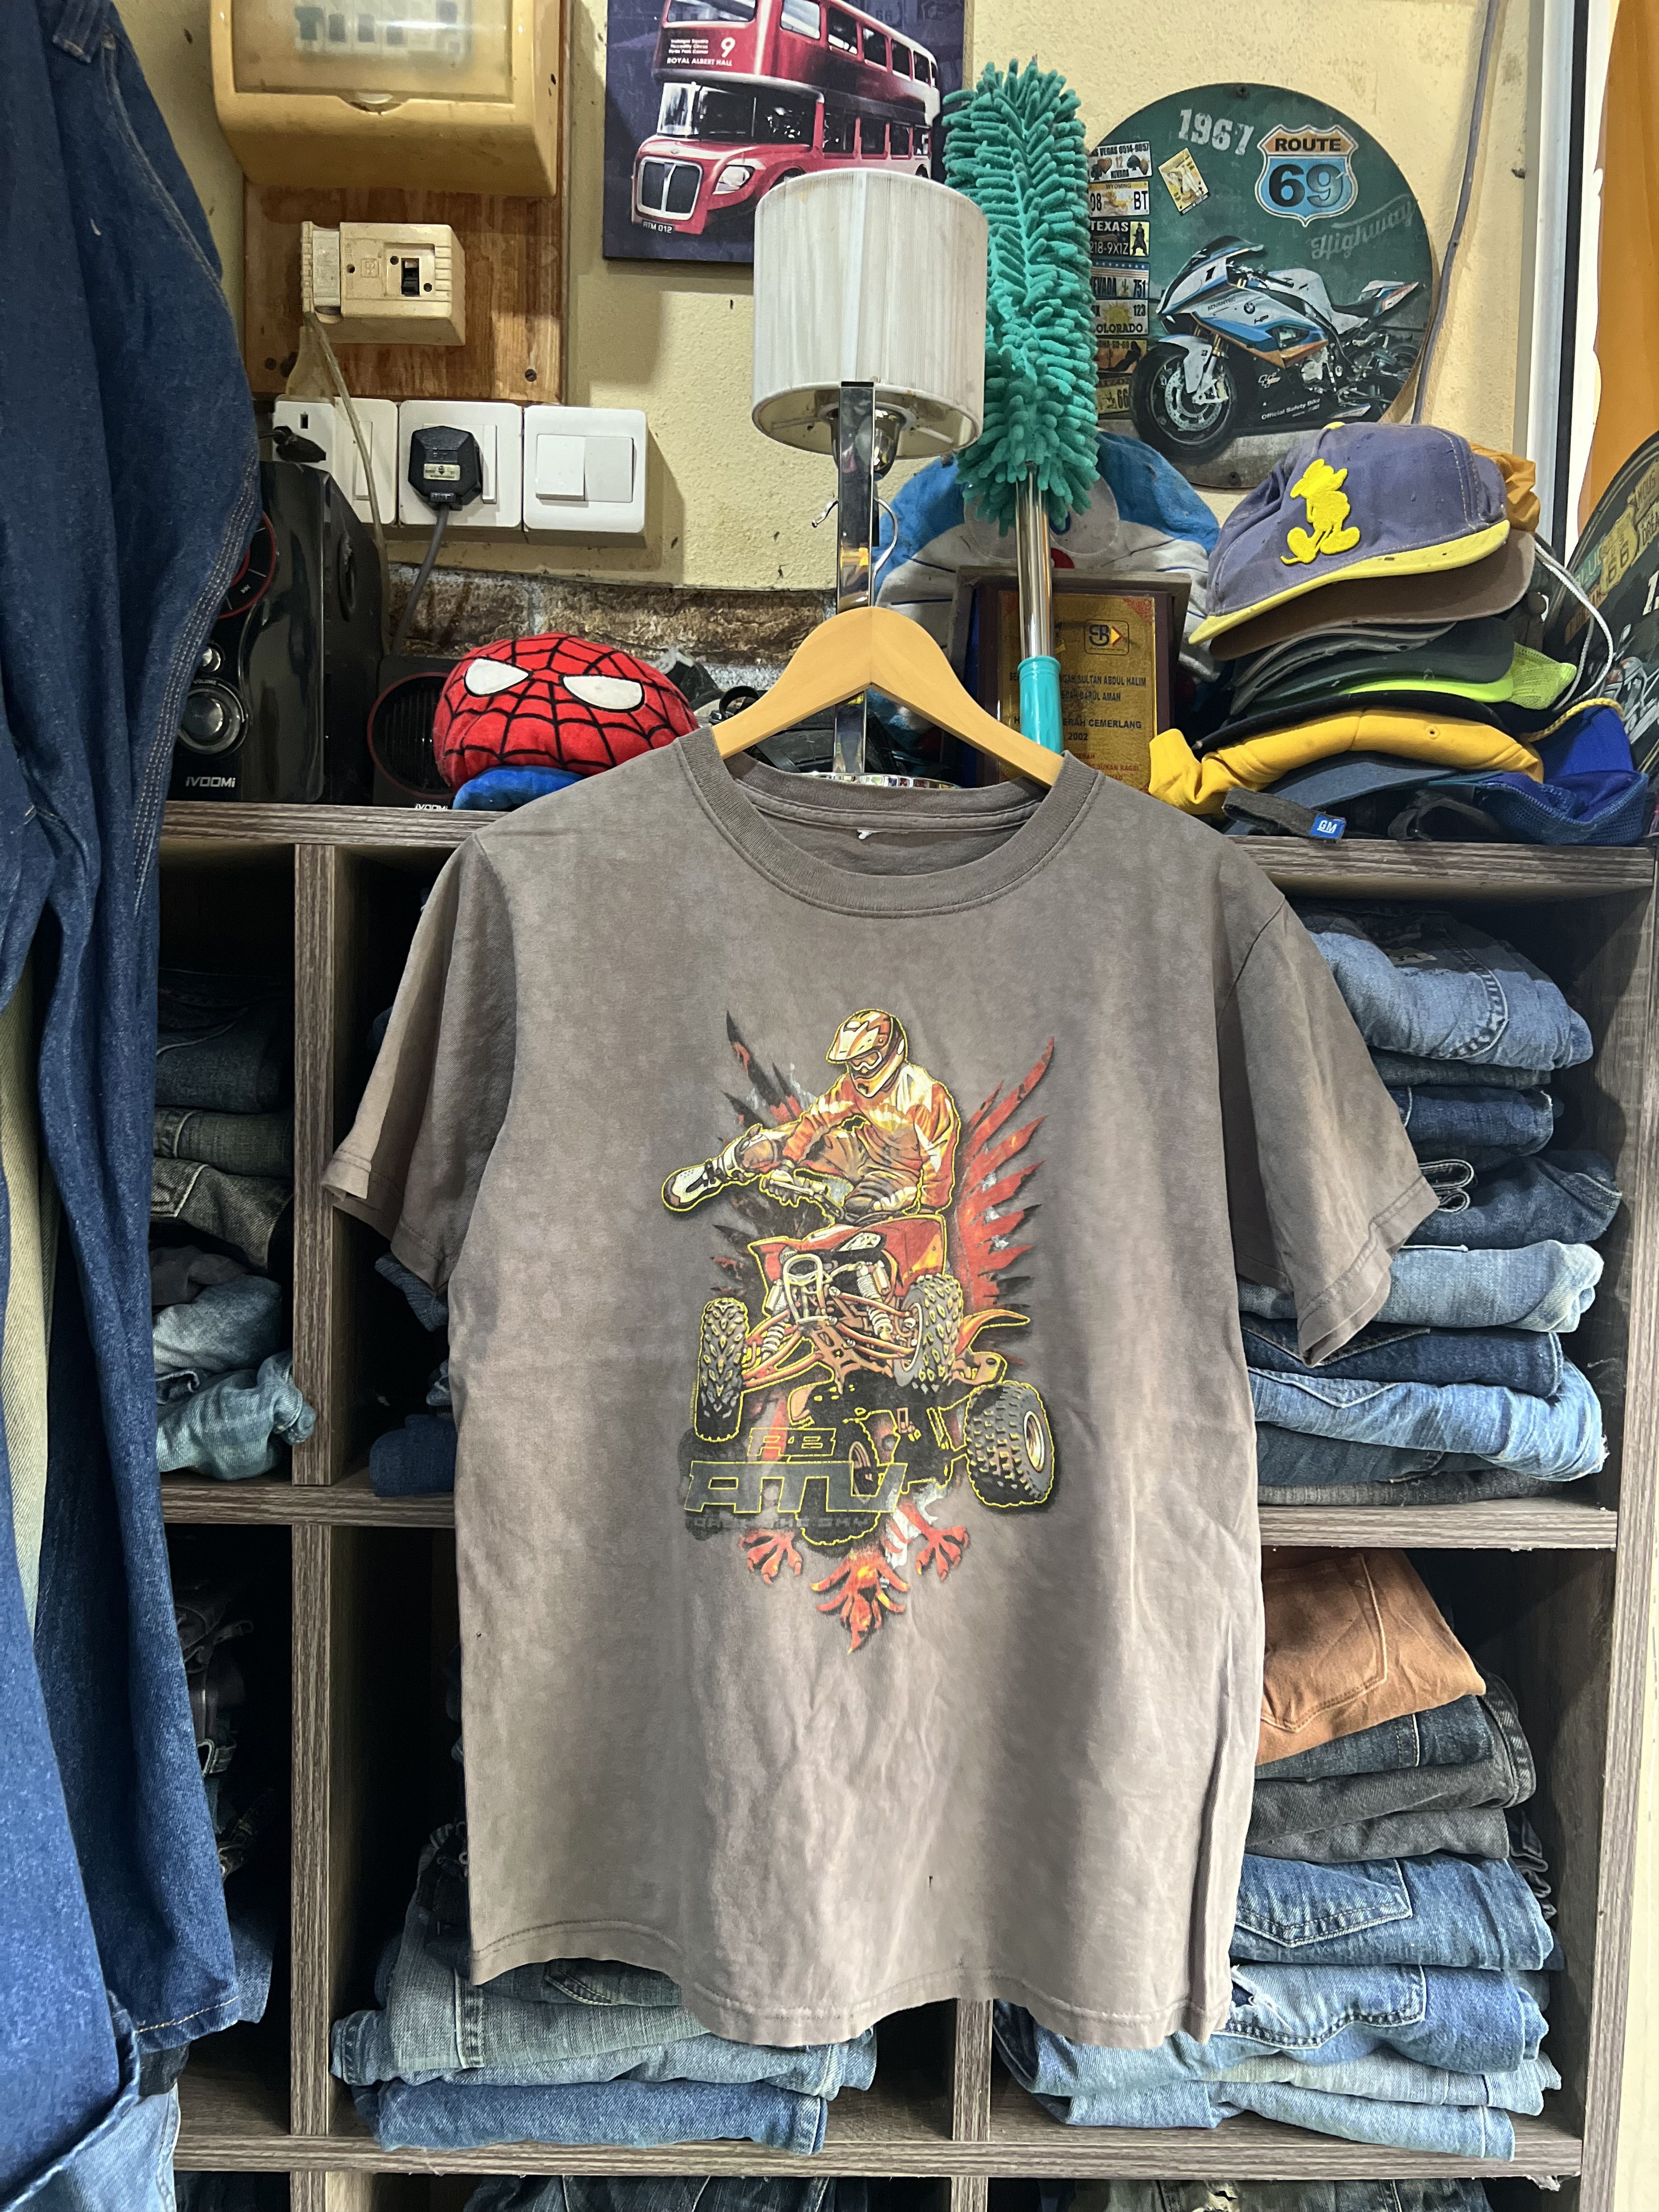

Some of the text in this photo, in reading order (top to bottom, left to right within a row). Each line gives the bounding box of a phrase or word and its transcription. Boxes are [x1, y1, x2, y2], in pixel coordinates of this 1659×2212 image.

[721, 36, 736, 58] 9
[1178, 109, 1255, 155] 1967
[1275, 138, 1341, 152] ROUTE
[1268, 164, 1343, 208] 69
[1134, 191, 1148, 210] BT
[1091, 220, 1129, 232] TEXAS
[1311, 199, 1417, 260] Highway
[1133, 304, 1146, 317] 123
[1094, 323, 1143, 334] OLORADO
[1261, 409, 1285, 420] Official
[1286, 403, 1306, 413] Safety
[1078, 675, 1102, 684] SULTAN
[1103, 675, 1124, 686] ABDUL
[1126, 677, 1147, 687] HALIM
[1080, 692, 1101, 701] DARUL
[1102, 692, 1121, 701] AMAN
[1088, 719, 1142, 729] CEMERLANG
[1068, 732, 1088, 741] 2002
[1317, 819, 1338, 834] GM
[684, 1460, 909, 1514] ATV
